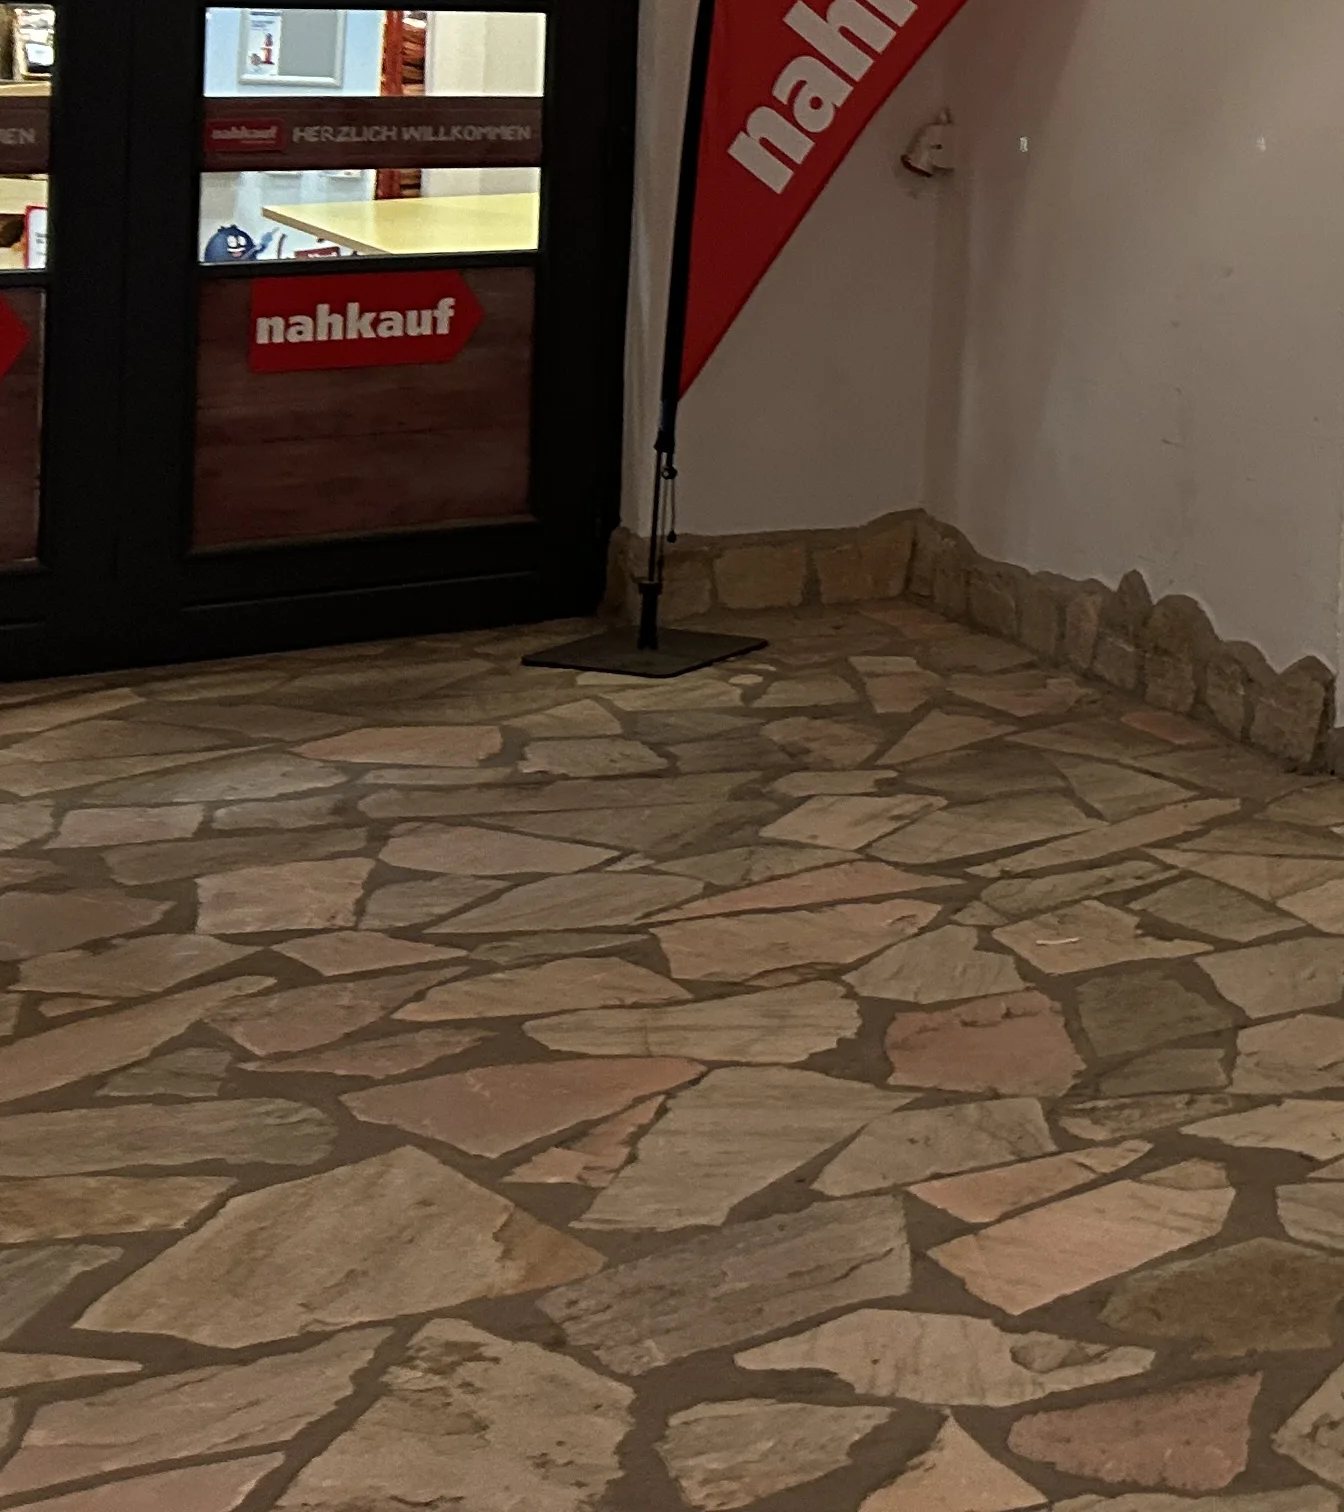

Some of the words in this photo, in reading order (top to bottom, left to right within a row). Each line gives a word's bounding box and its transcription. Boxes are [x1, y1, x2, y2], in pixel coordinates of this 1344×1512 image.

[293, 125, 398, 143] HERZLICH
[402, 124, 532, 143] WILLKOMMEN
[256, 296, 456, 345] nahkauf
